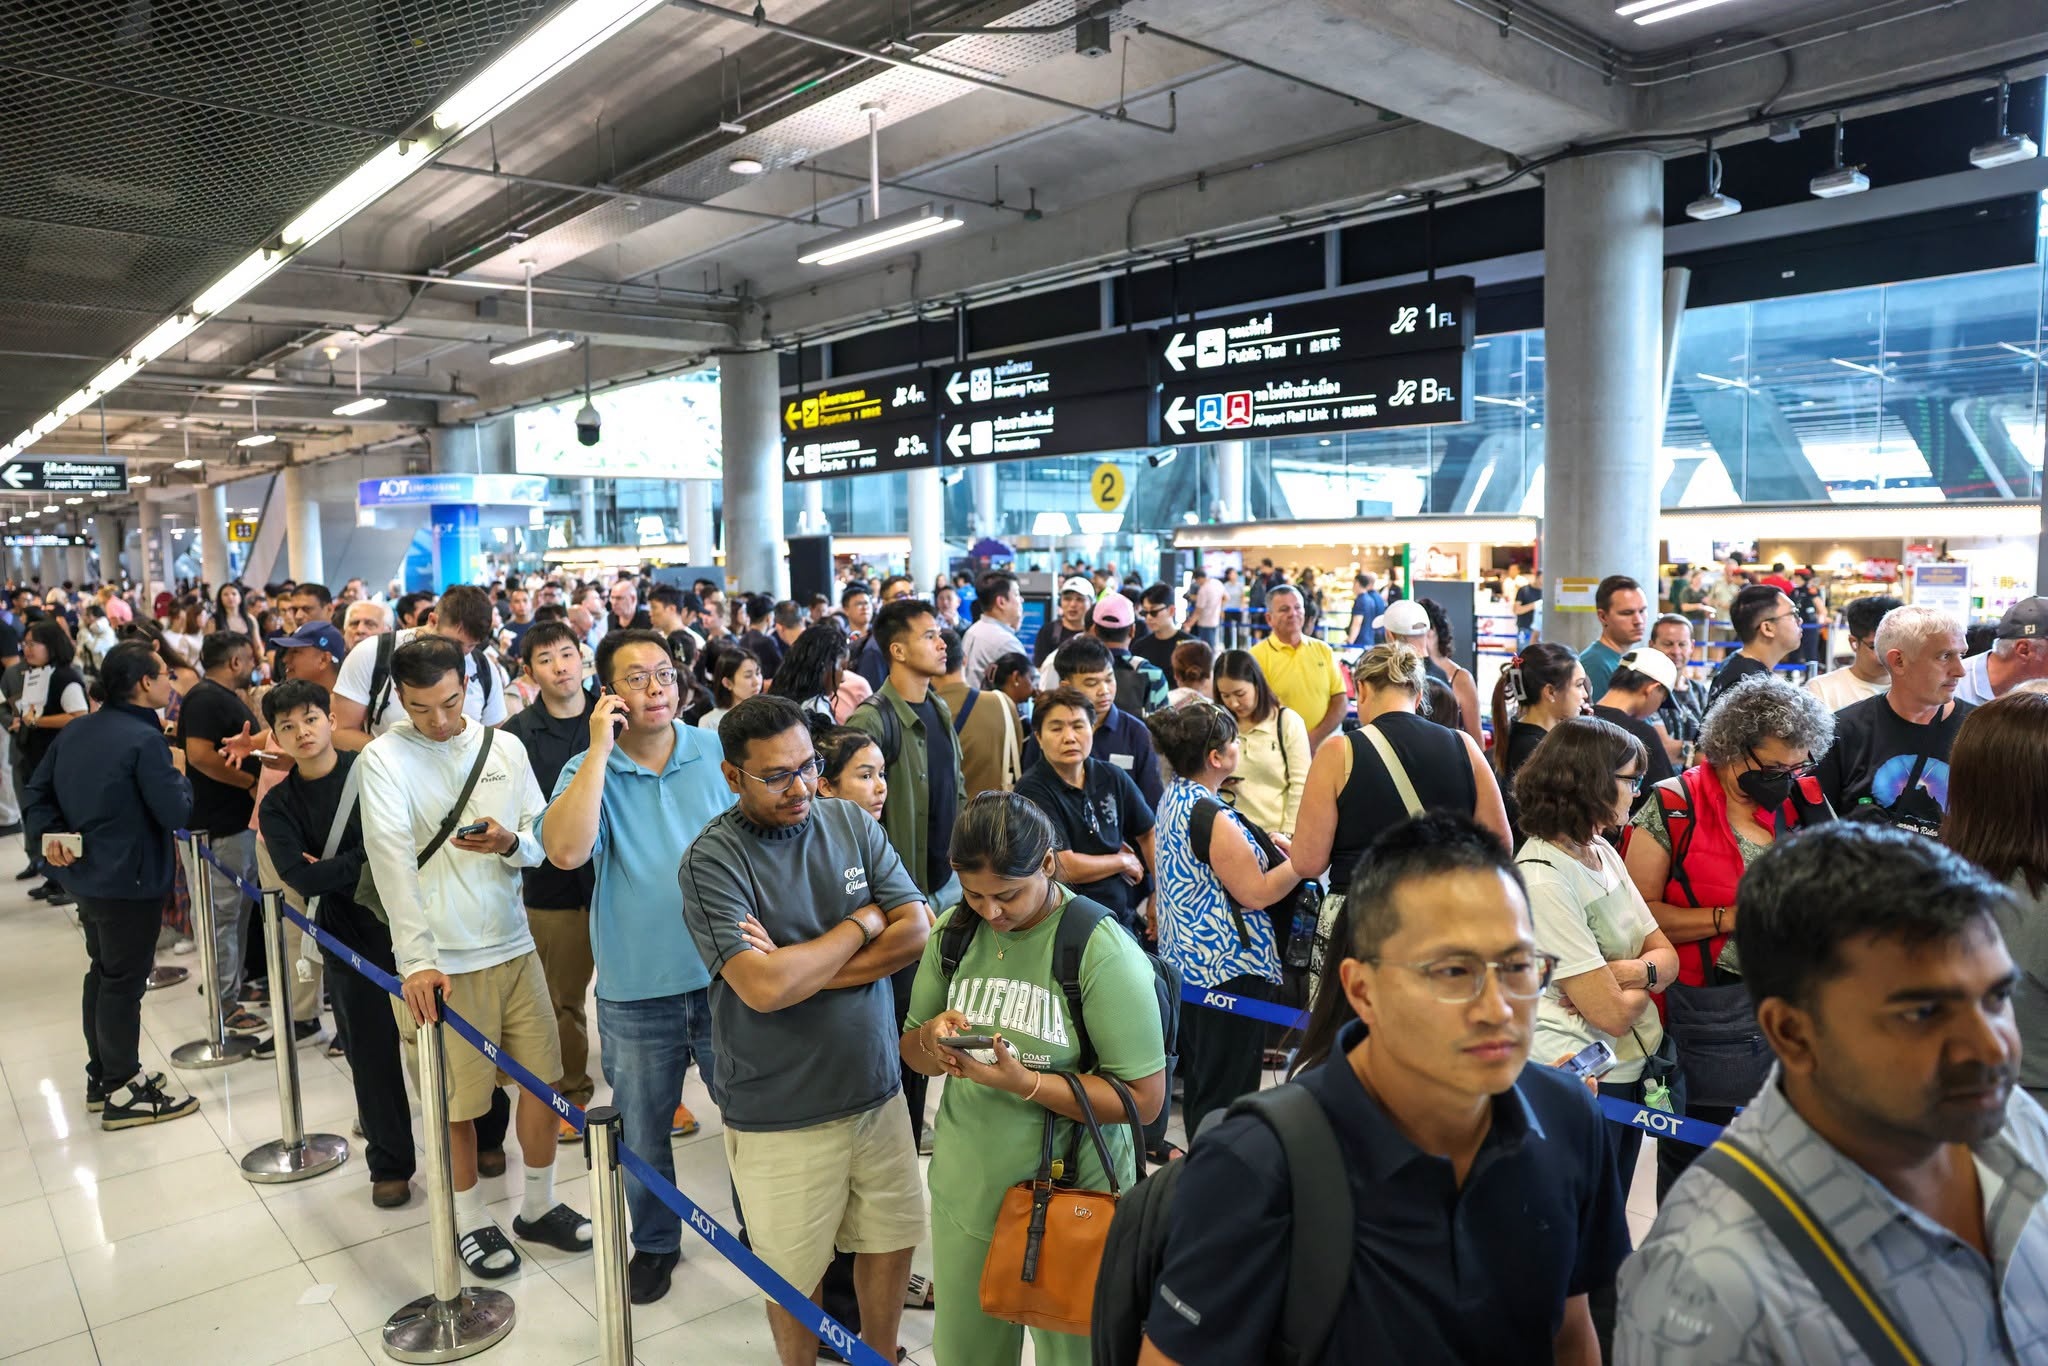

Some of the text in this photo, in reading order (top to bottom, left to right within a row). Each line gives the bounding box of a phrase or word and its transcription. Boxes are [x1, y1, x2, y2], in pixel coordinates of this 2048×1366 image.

[1228, 346, 1262, 364] Public
[1262, 342, 1286, 359] Taxi
[1307, 407, 1329, 421] Link
[378, 480, 409, 496] AOT
[1101, 472, 1115, 502] 2
[1203, 991, 1238, 1010] AOT
[484, 1040, 498, 1061] AOT
[1022, 1052, 1052, 1062] COAST
[552, 1092, 570, 1117] AOT
[1631, 1109, 1684, 1136] AOT
[690, 1207, 718, 1241] AOT
[818, 1316, 856, 1356] AOT
